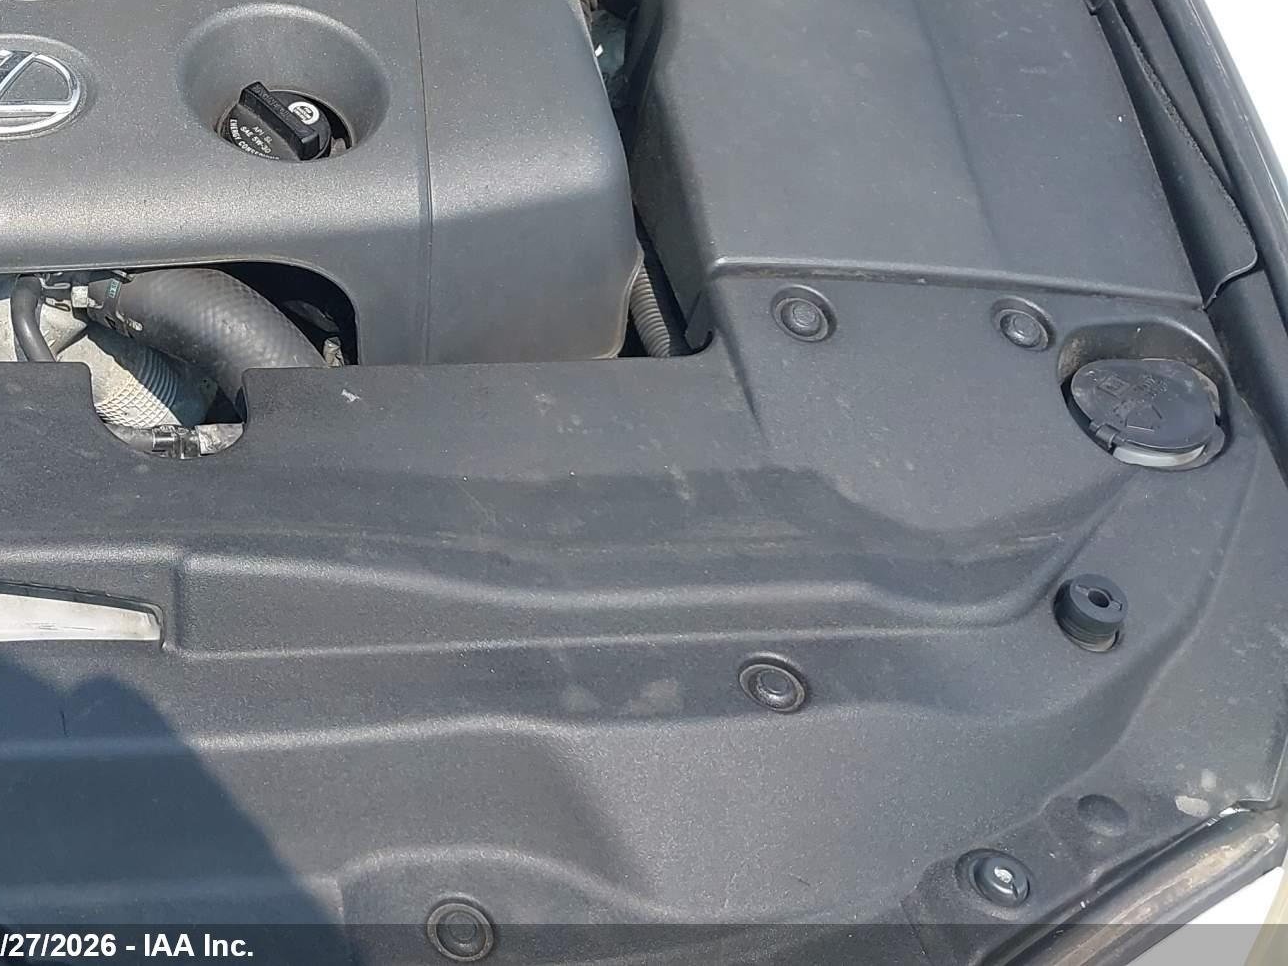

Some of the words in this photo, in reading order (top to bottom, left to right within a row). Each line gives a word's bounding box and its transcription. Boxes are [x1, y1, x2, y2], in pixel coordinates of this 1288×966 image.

[240, 126, 253, 137] SAE
[251, 136, 272, 153] 5W-30
[253, 126, 264, 135] API
[238, 141, 280, 160] CONSE
